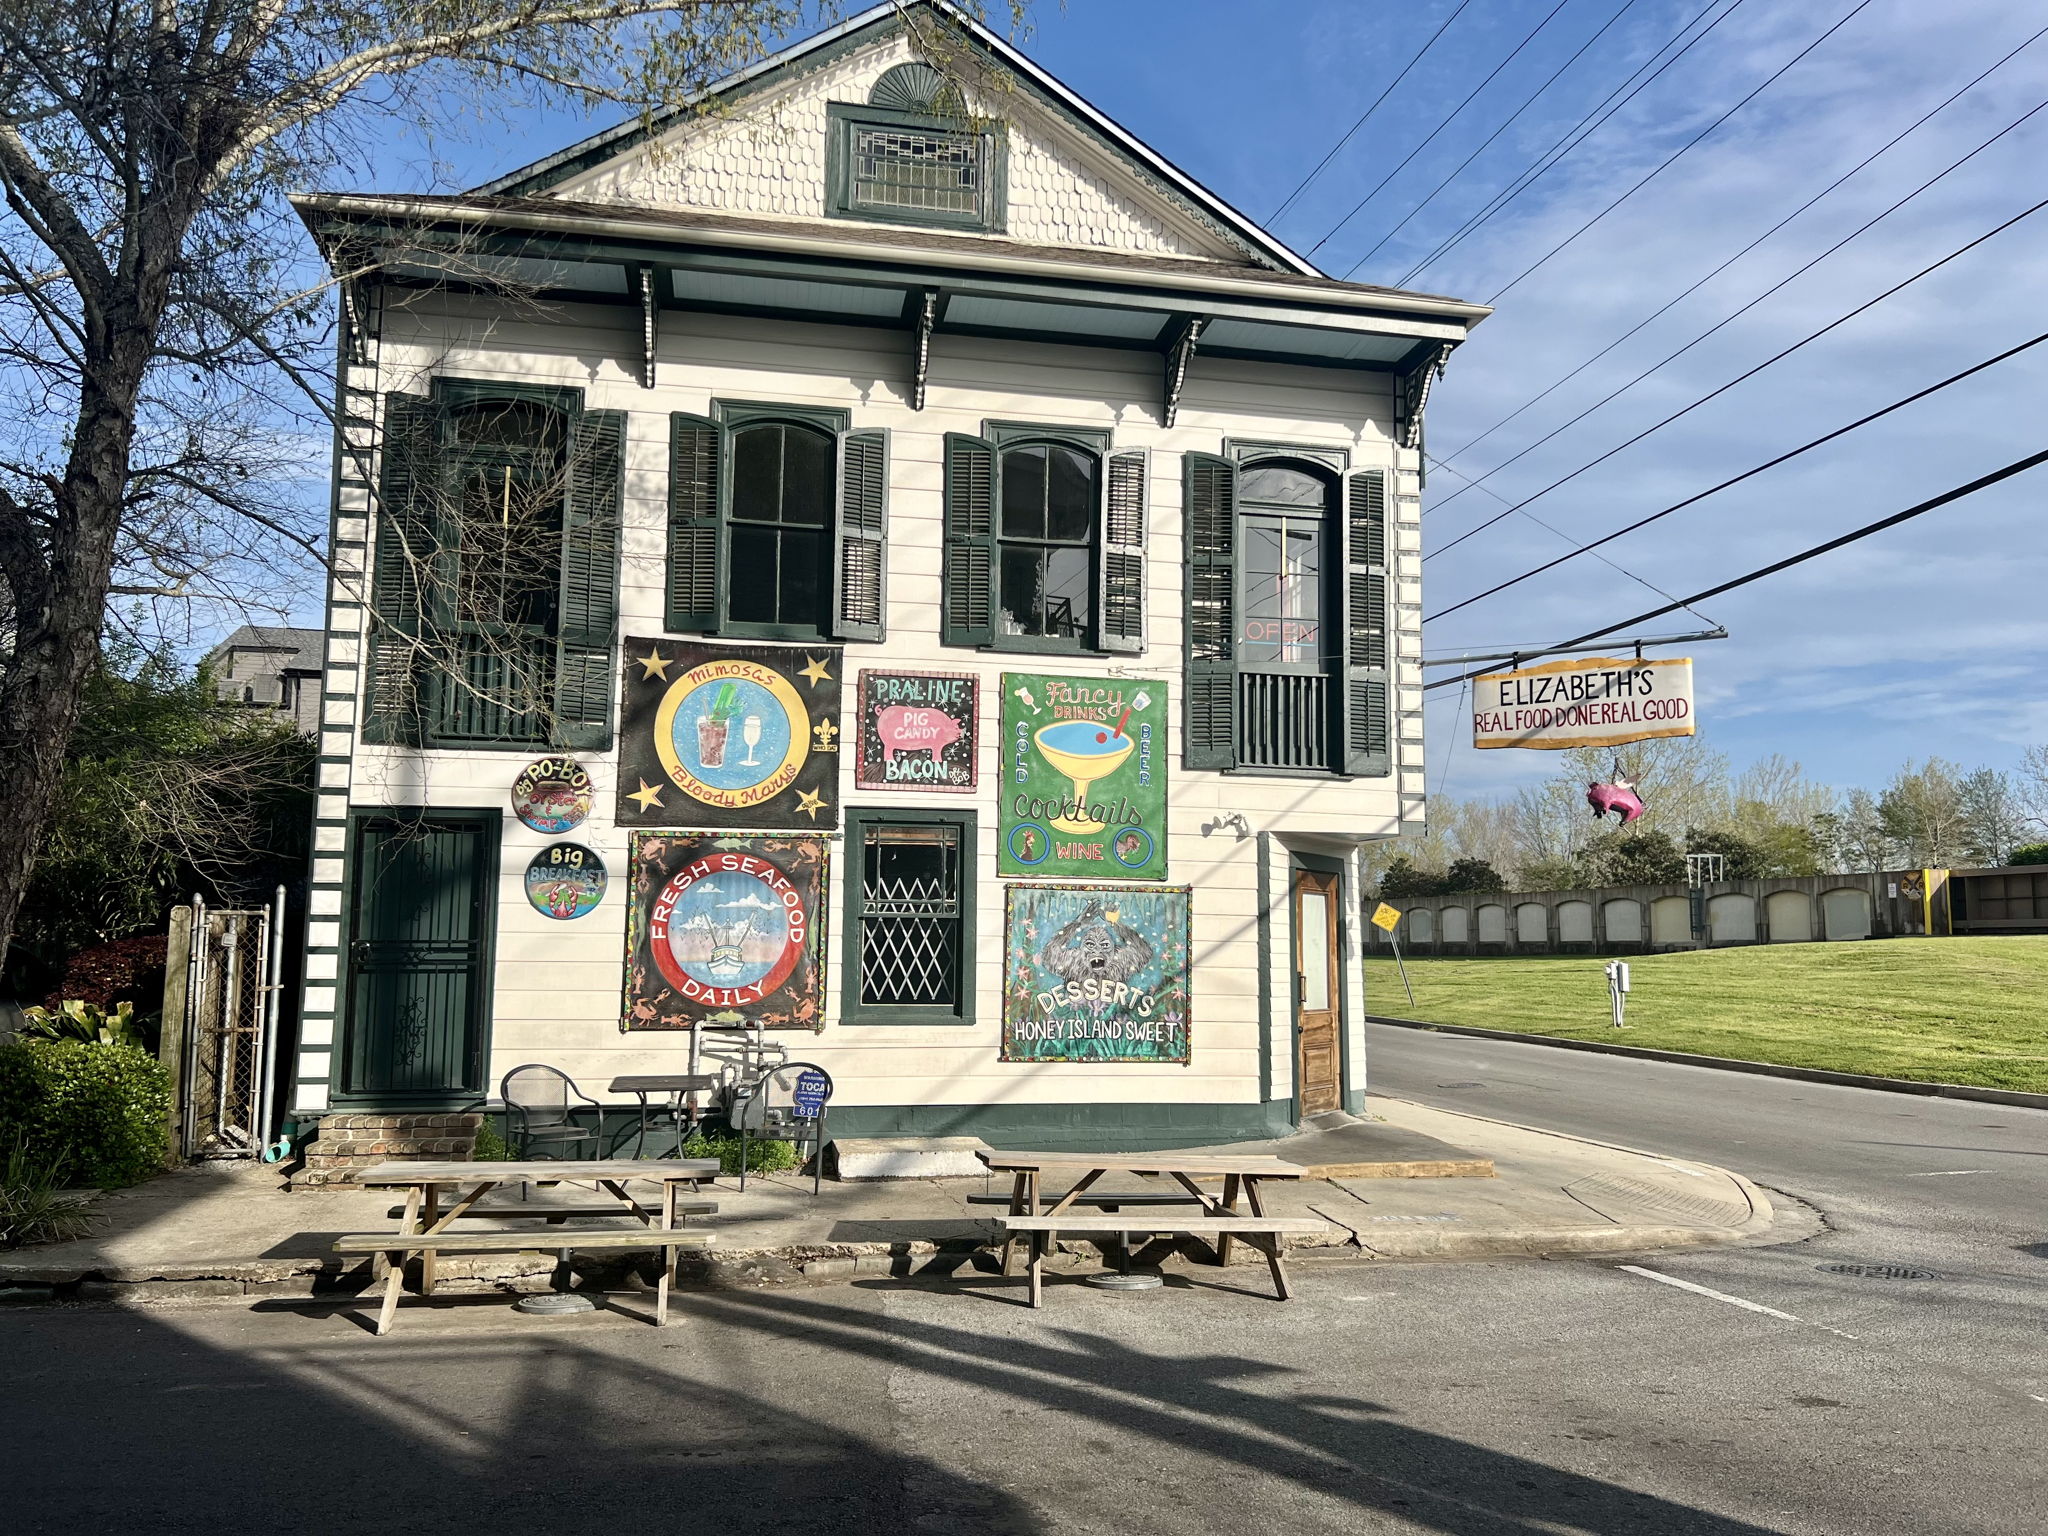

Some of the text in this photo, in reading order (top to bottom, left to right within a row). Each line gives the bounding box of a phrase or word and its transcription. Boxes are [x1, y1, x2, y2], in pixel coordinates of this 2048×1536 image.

[1246, 622, 1314, 642] OPEN
[876, 679, 964, 703] PRALINE
[1045, 682, 1126, 717] Fancy
[1500, 670, 1654, 707] ELIZABETH'S
[903, 712, 929, 726] PIG
[1054, 705, 1107, 721] DRINKS
[1474, 698, 1689, 733] REAL FOOD DONE REAL GOOD
[894, 726, 941, 740] CANDY
[1015, 720, 1030, 784] COLD
[1139, 724, 1151, 787] BEER
[885, 759, 948, 780] BACON
[671, 763, 797, 807] Bloody Marys
[1014, 793, 1143, 825] Cocktails
[550, 848, 584, 870] Big
[1056, 842, 1105, 860] WINE
[530, 867, 605, 882] BREAKFAST
[651, 854, 806, 943] FRESH SEAFOOD
[681, 978, 765, 1006] DAILY
[1037, 978, 1156, 1017] DESSERTS
[1015, 1020, 1178, 1043] HONEY ISLAND SWEET
[800, 1081, 825, 1092] TOCA
